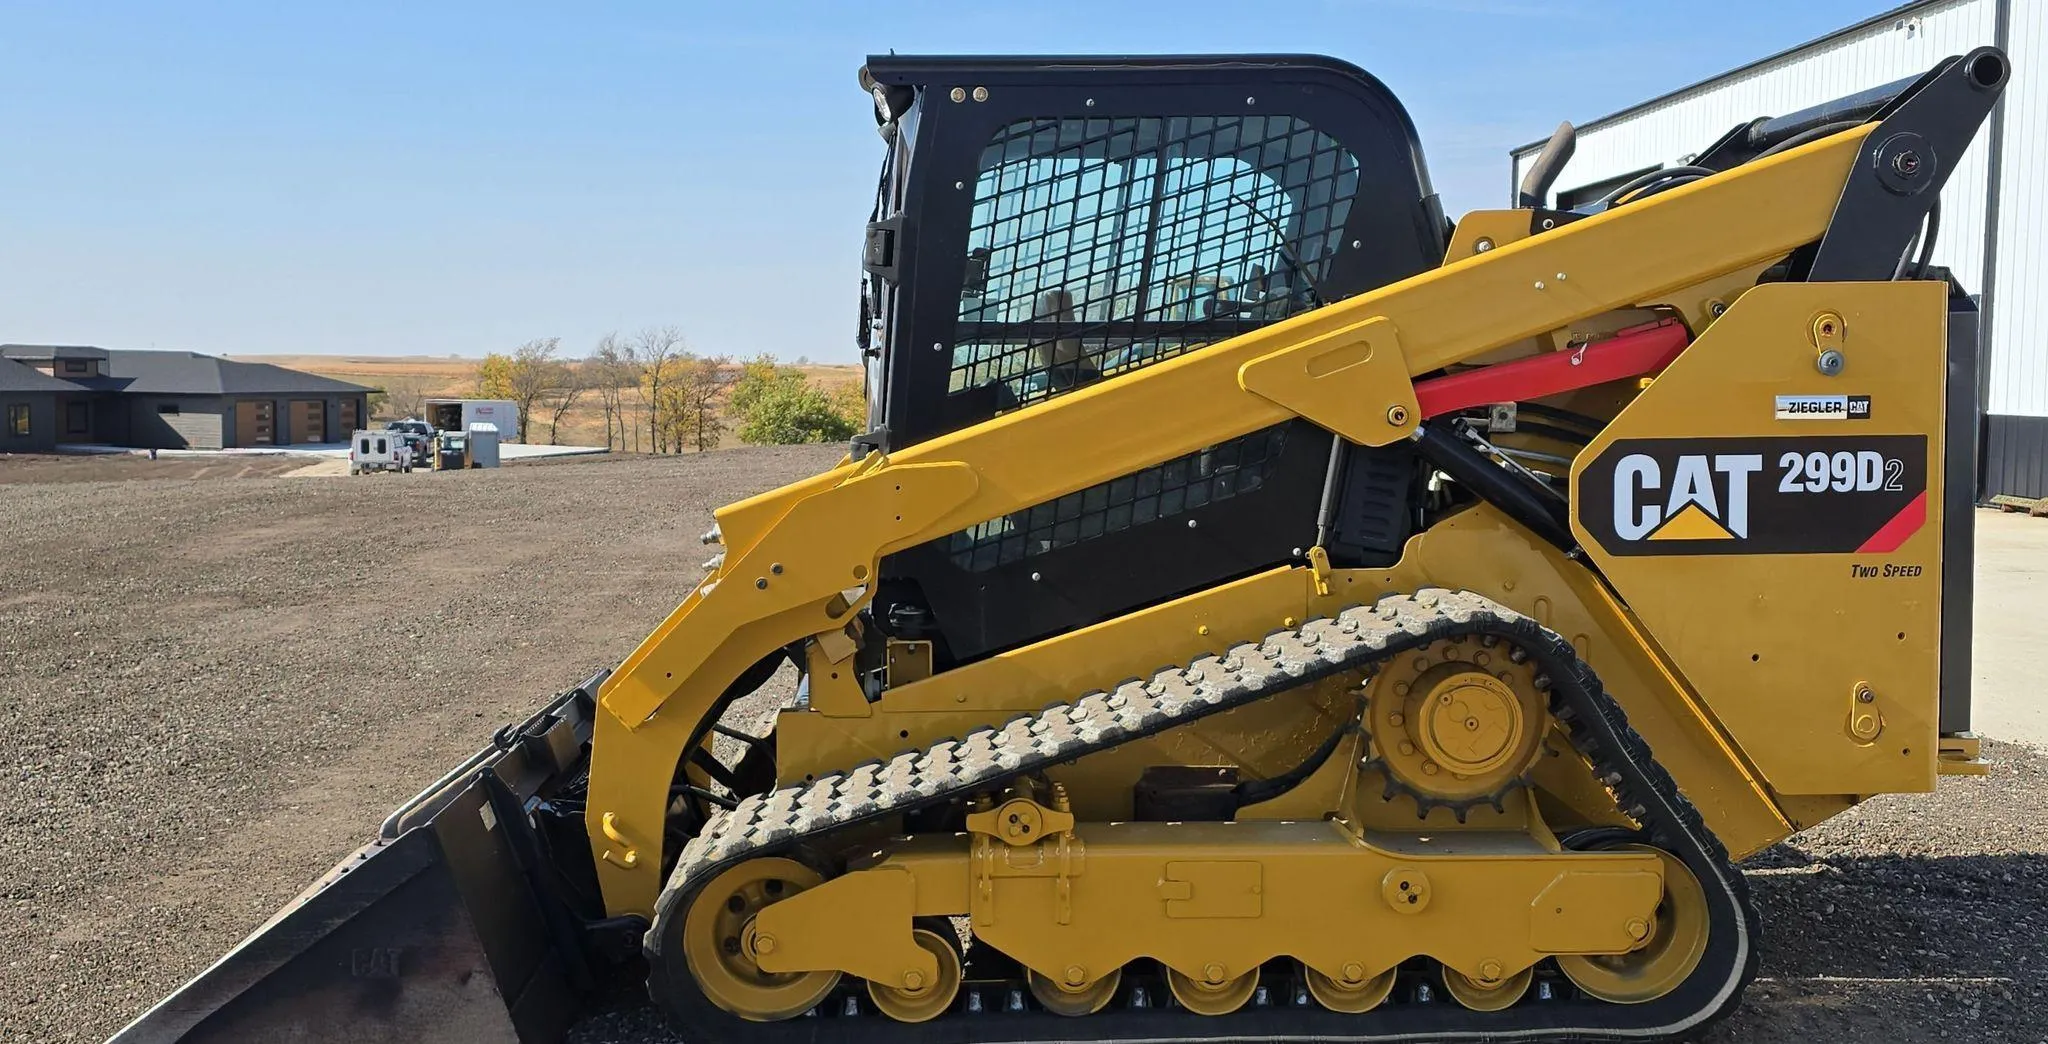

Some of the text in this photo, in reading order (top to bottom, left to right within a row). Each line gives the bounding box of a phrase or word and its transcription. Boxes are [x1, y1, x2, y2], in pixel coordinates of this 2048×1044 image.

[1788, 401, 1869, 414] ZIEGLER CAT
[1613, 451, 1904, 541] CAT 299D2
[1851, 563, 1923, 578] TWO SPEED
